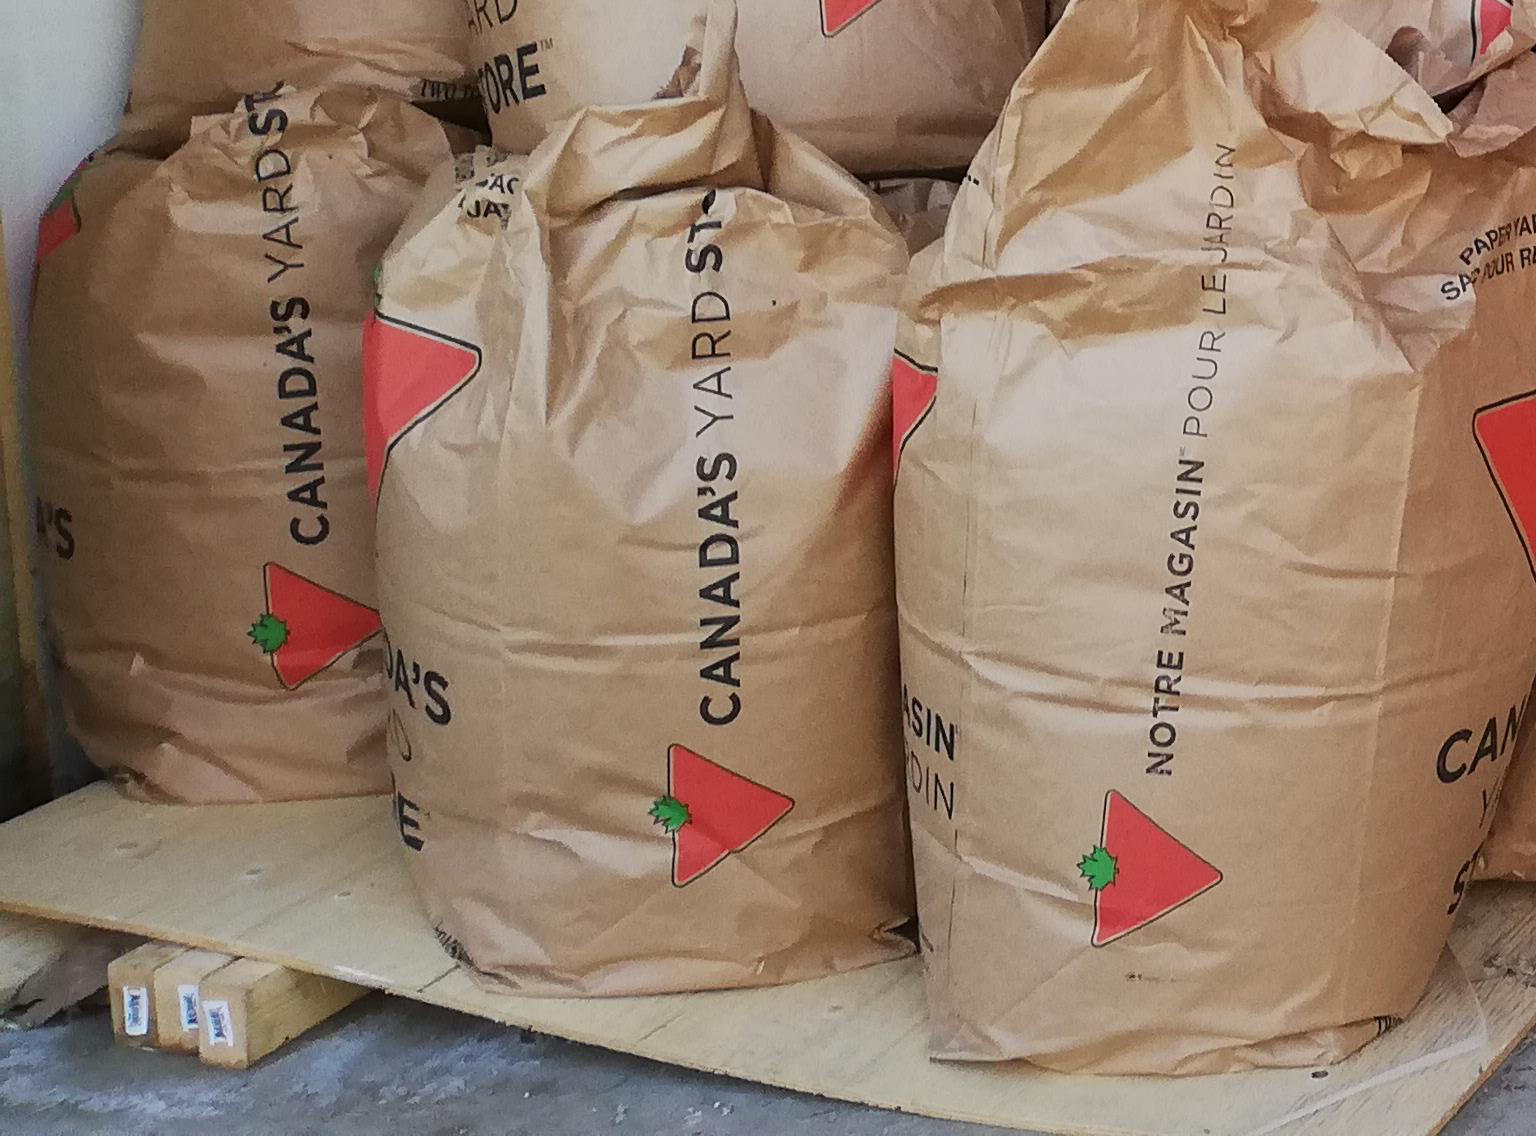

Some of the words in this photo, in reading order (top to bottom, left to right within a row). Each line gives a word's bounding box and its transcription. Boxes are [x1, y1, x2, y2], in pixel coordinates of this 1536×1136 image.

[478, 42, 547, 114] ORE
[255, 146, 304, 283] YARD
[1201, 143, 1236, 263] JARDIN
[1201, 273, 1227, 315] LE
[271, 296, 330, 545] CANADA'S
[691, 291, 733, 439] YARD
[1183, 331, 1226, 438] POUR
[696, 452, 742, 726] CANADA'S
[1160, 460, 1205, 635] MAGASIN
[902, 683, 954, 761] ASIN
[1146, 650, 1184, 776] NOTRE
[909, 750, 954, 821] DIN
